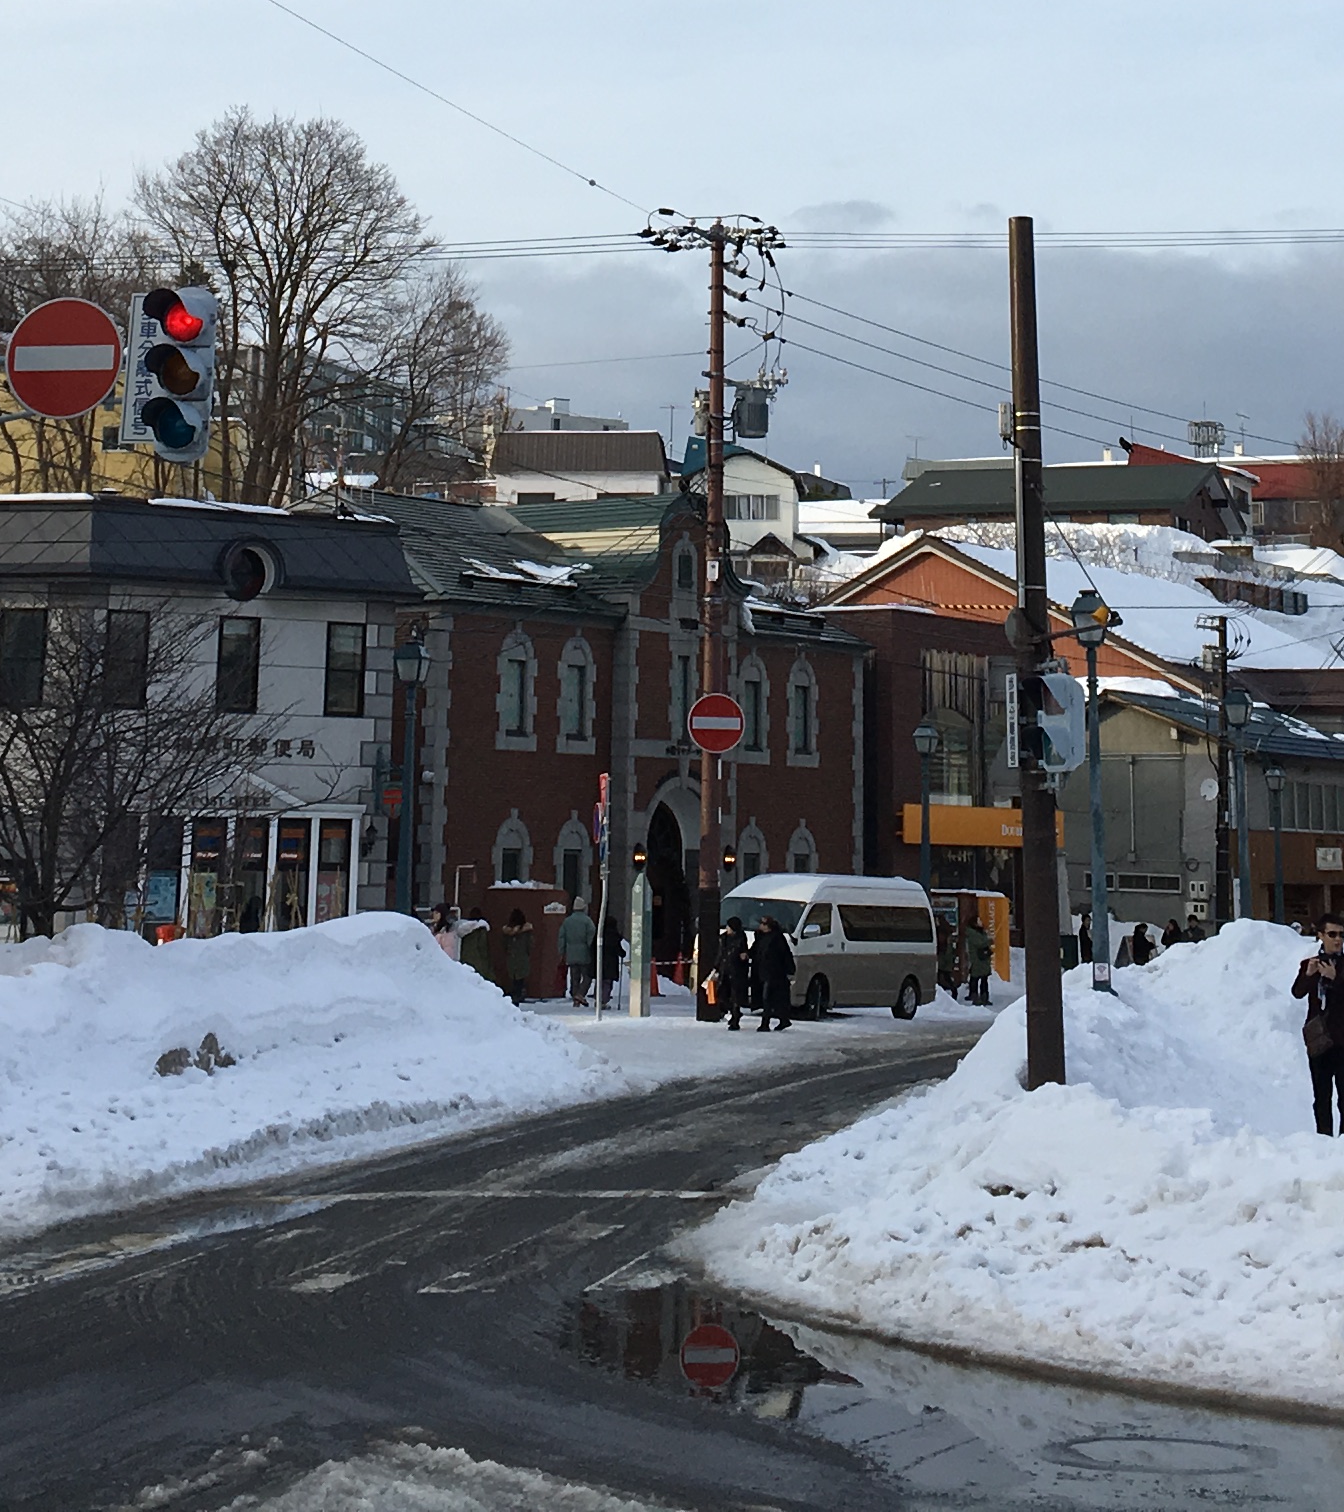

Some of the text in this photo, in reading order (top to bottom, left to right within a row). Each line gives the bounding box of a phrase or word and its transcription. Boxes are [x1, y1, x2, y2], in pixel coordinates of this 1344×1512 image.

[132, 304, 158, 436] 車分離式信号
